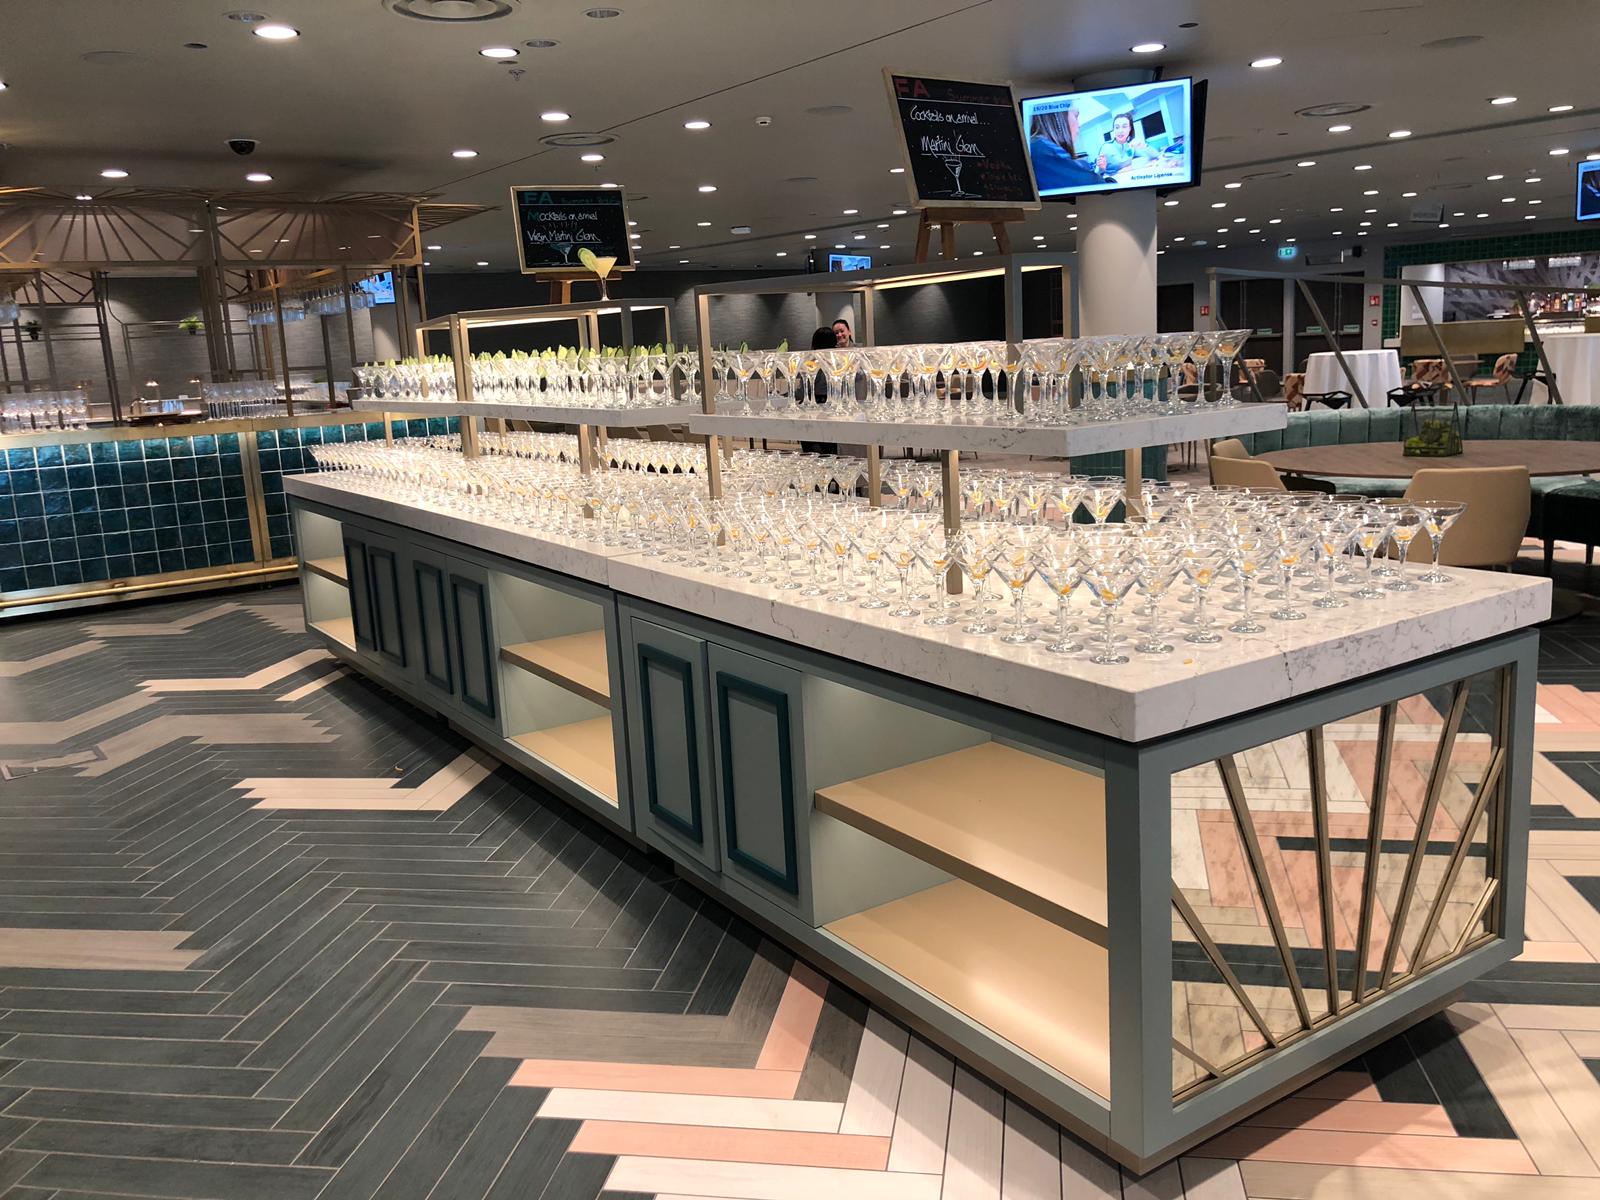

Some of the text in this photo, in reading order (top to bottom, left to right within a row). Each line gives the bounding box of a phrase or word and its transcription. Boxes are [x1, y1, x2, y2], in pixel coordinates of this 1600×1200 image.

[893, 78, 930, 98] FA
[910, 104, 945, 122] Cocktails
[945, 113, 959, 124] on
[920, 134, 955, 158] Martini
[524, 192, 554, 204] FA
[527, 211, 567, 221] Mocktails
[568, 213, 578, 222] on
